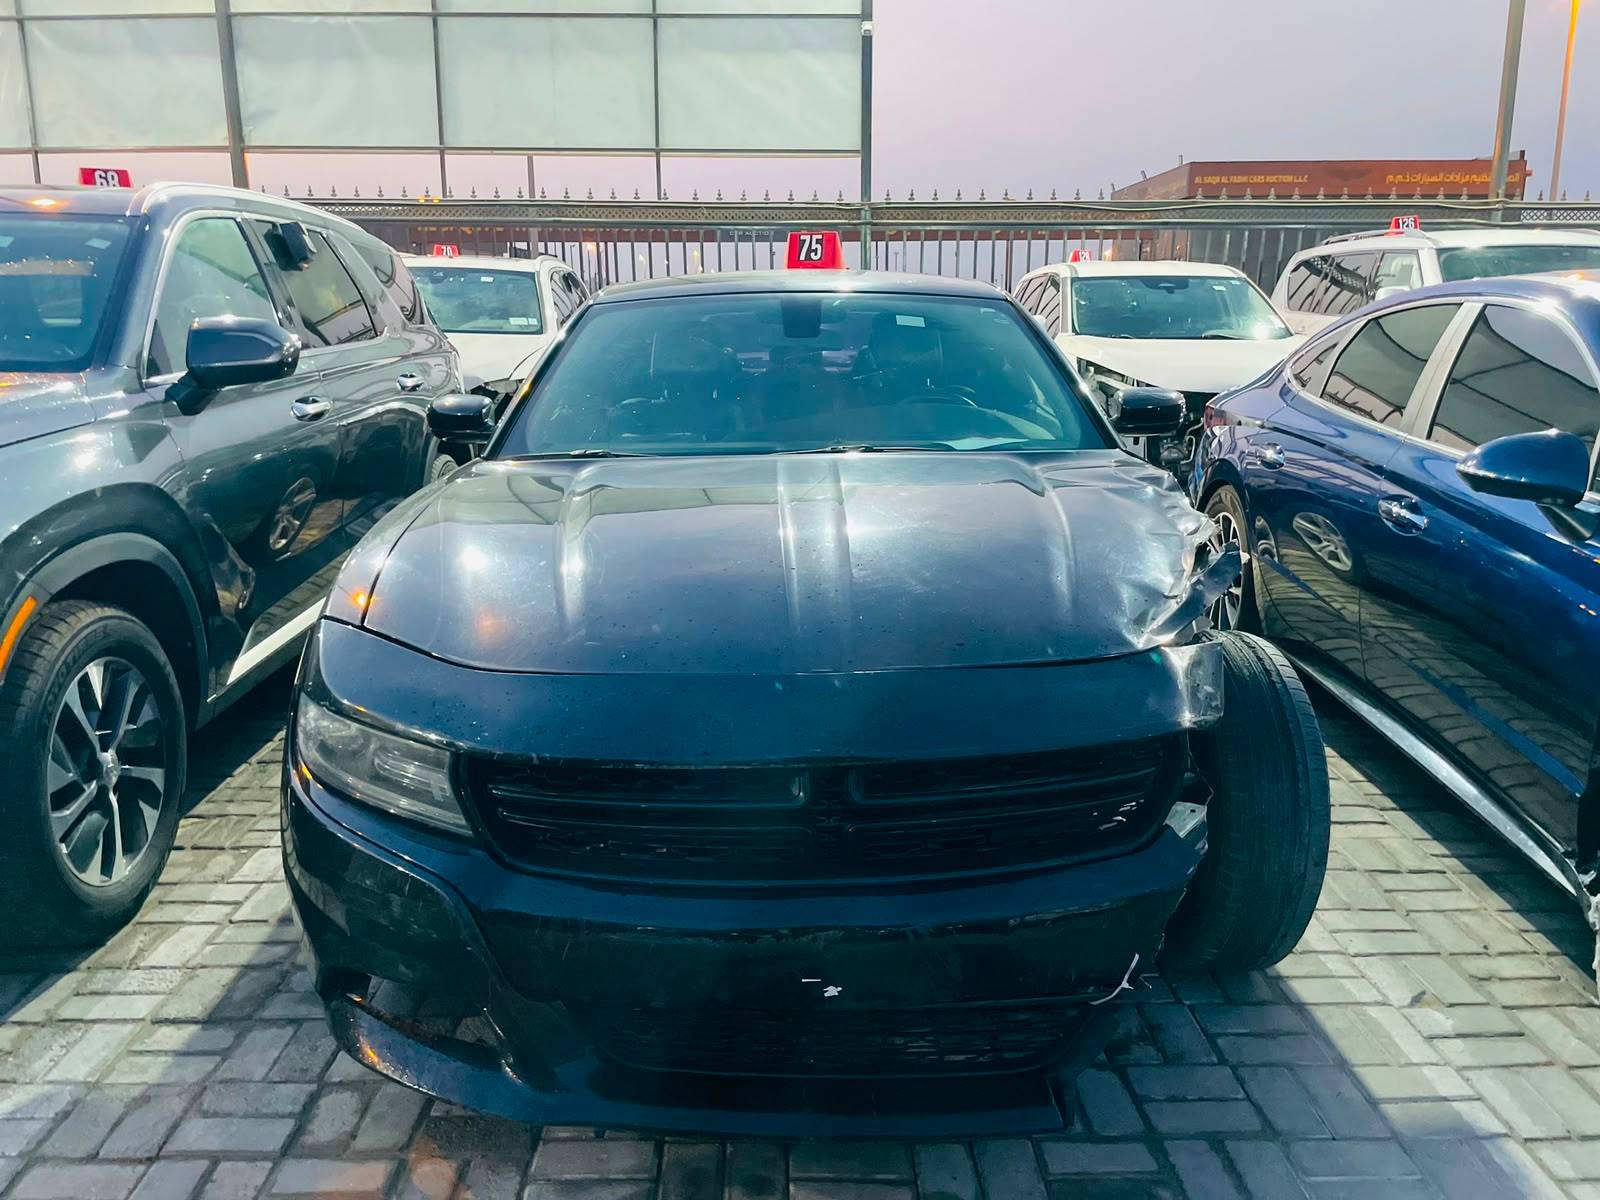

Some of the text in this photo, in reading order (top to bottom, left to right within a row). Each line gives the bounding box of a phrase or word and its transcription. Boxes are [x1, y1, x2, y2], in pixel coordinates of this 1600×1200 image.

[94, 170, 120, 188] 68
[1399, 217, 1415, 231] 126
[800, 234, 822, 261] 75
